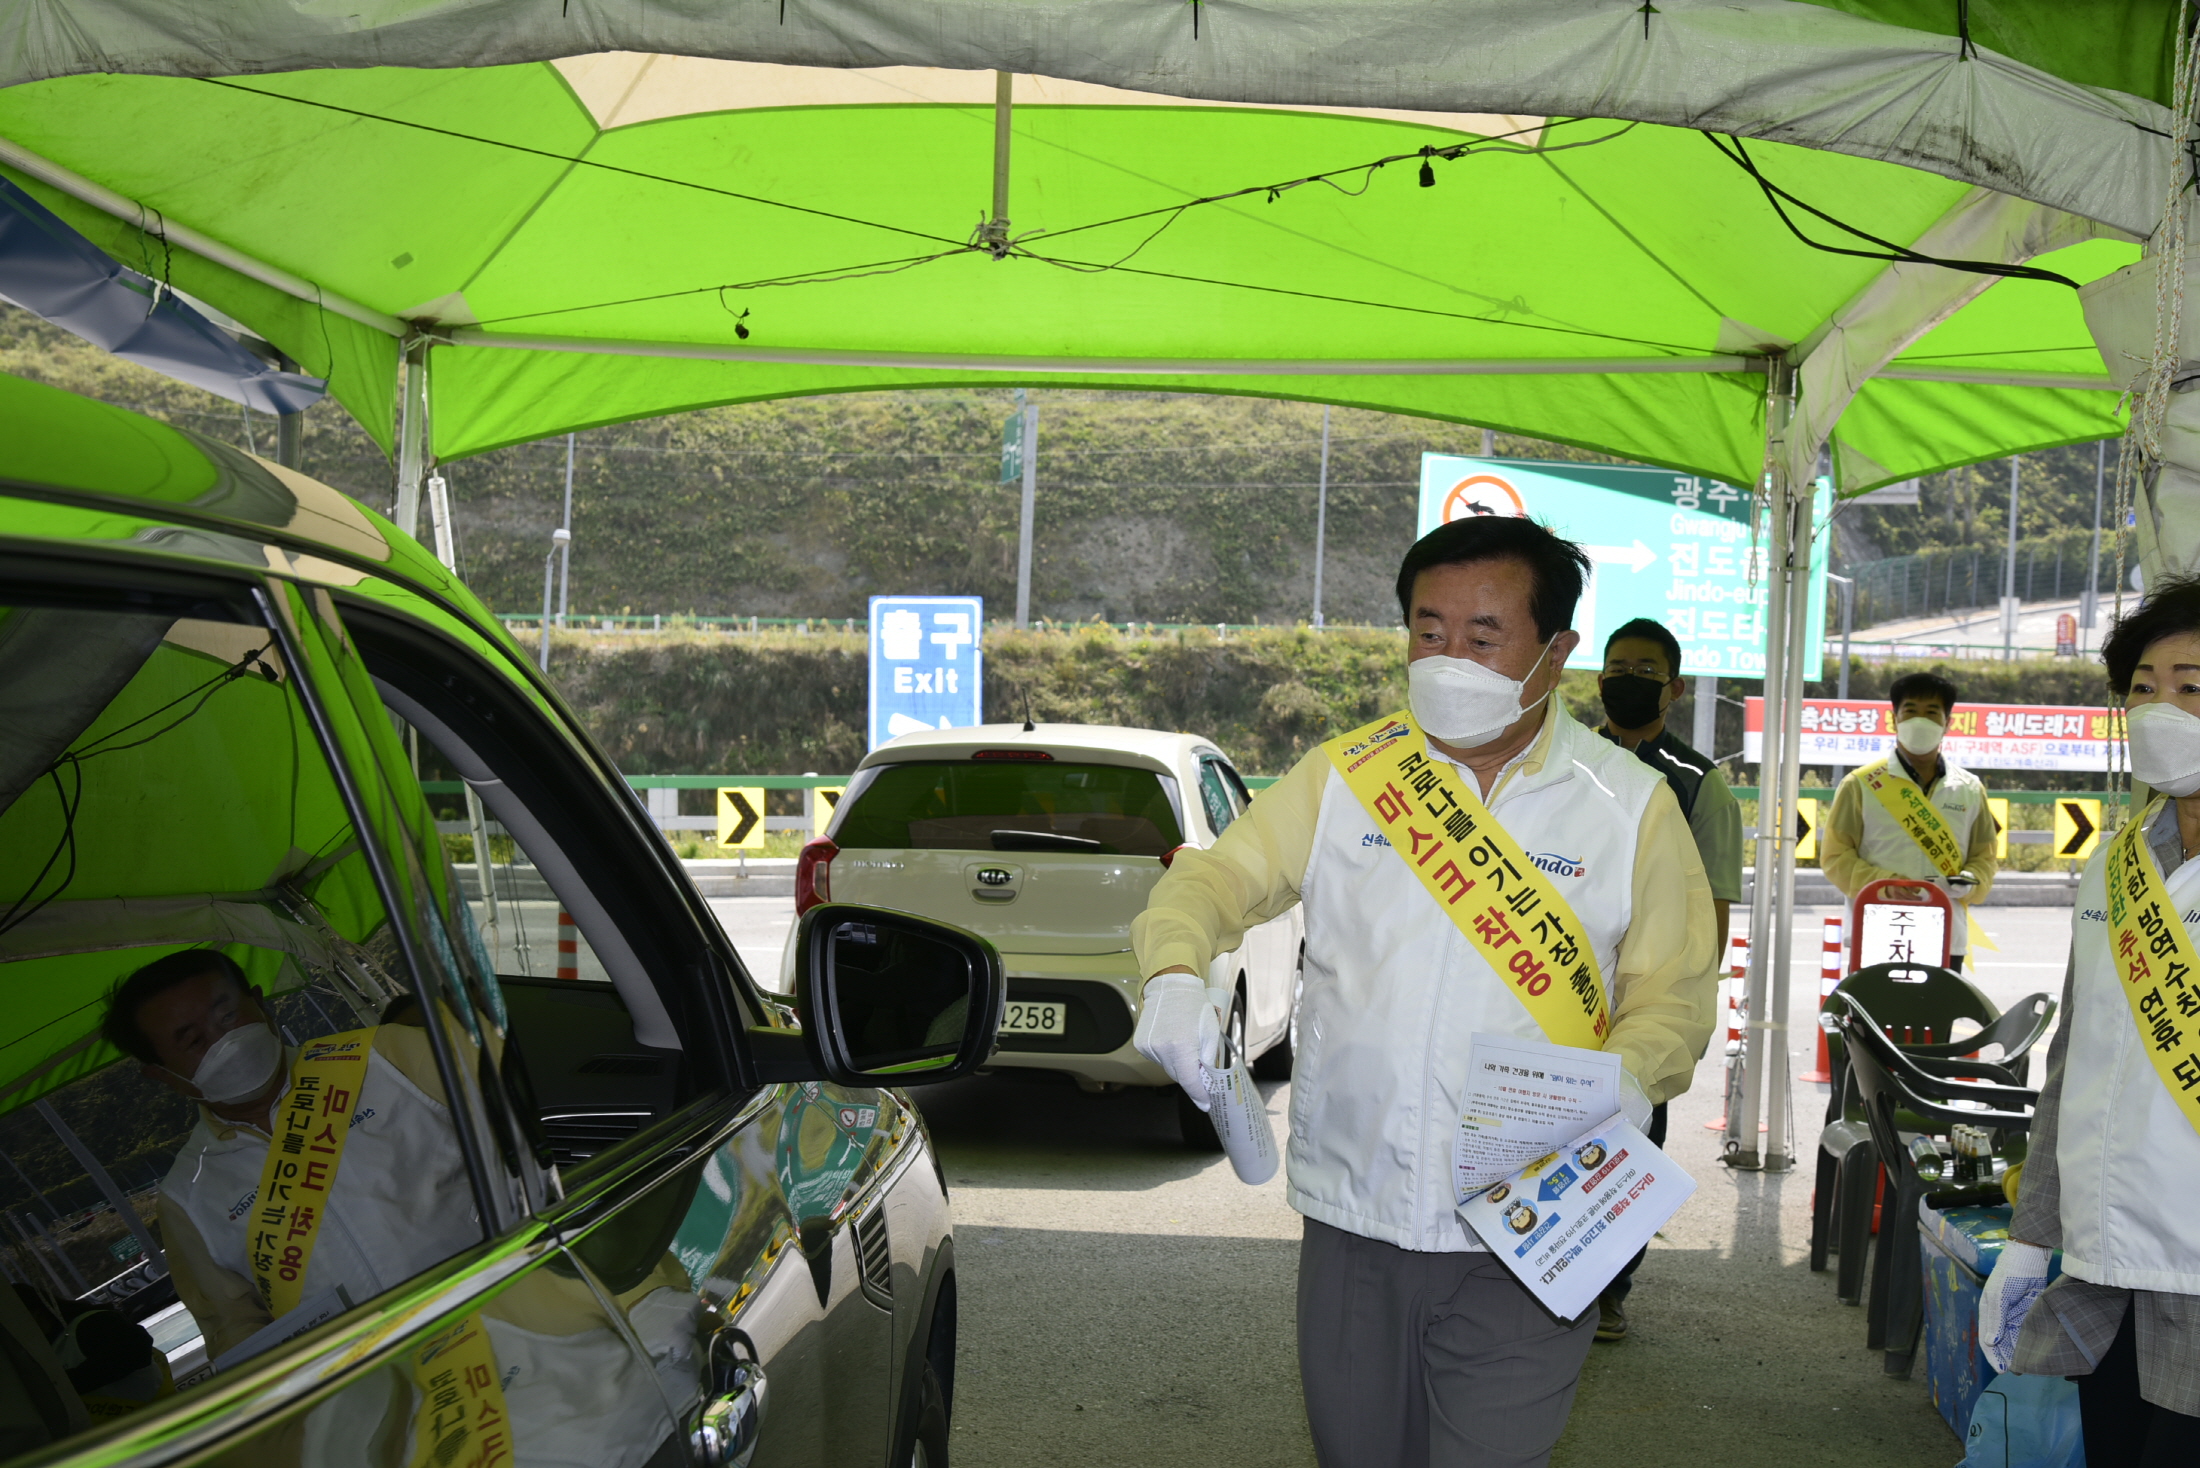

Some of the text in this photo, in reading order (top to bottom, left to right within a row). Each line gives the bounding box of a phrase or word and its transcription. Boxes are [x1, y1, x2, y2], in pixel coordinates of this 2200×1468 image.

[1669, 513, 1746, 543] Gwangju
[1668, 542, 1769, 582] 진도읍
[881, 609, 972, 660] 출구
[1664, 606, 1767, 646] 진도타
[894, 666, 958, 694] Exit
[1801, 706, 1880, 733] 축산농장
[981, 870, 1007, 883] KIA
[1373, 781, 1477, 905] 마스크
[1472, 905, 1552, 996] 착용
[1398, 751, 1477, 843] 코로나를
[1468, 835, 1541, 917] 이기는
[1530, 911, 1578, 967] 가장
[1569, 961, 1599, 1017] 좋은
[2138, 901, 2178, 960] 방역
[2118, 929, 2151, 984] 추석
[2139, 986, 2183, 1052] 연휴
[1539, 1172, 1655, 1285] 마스크 착용이 최고의 백신입니다.
